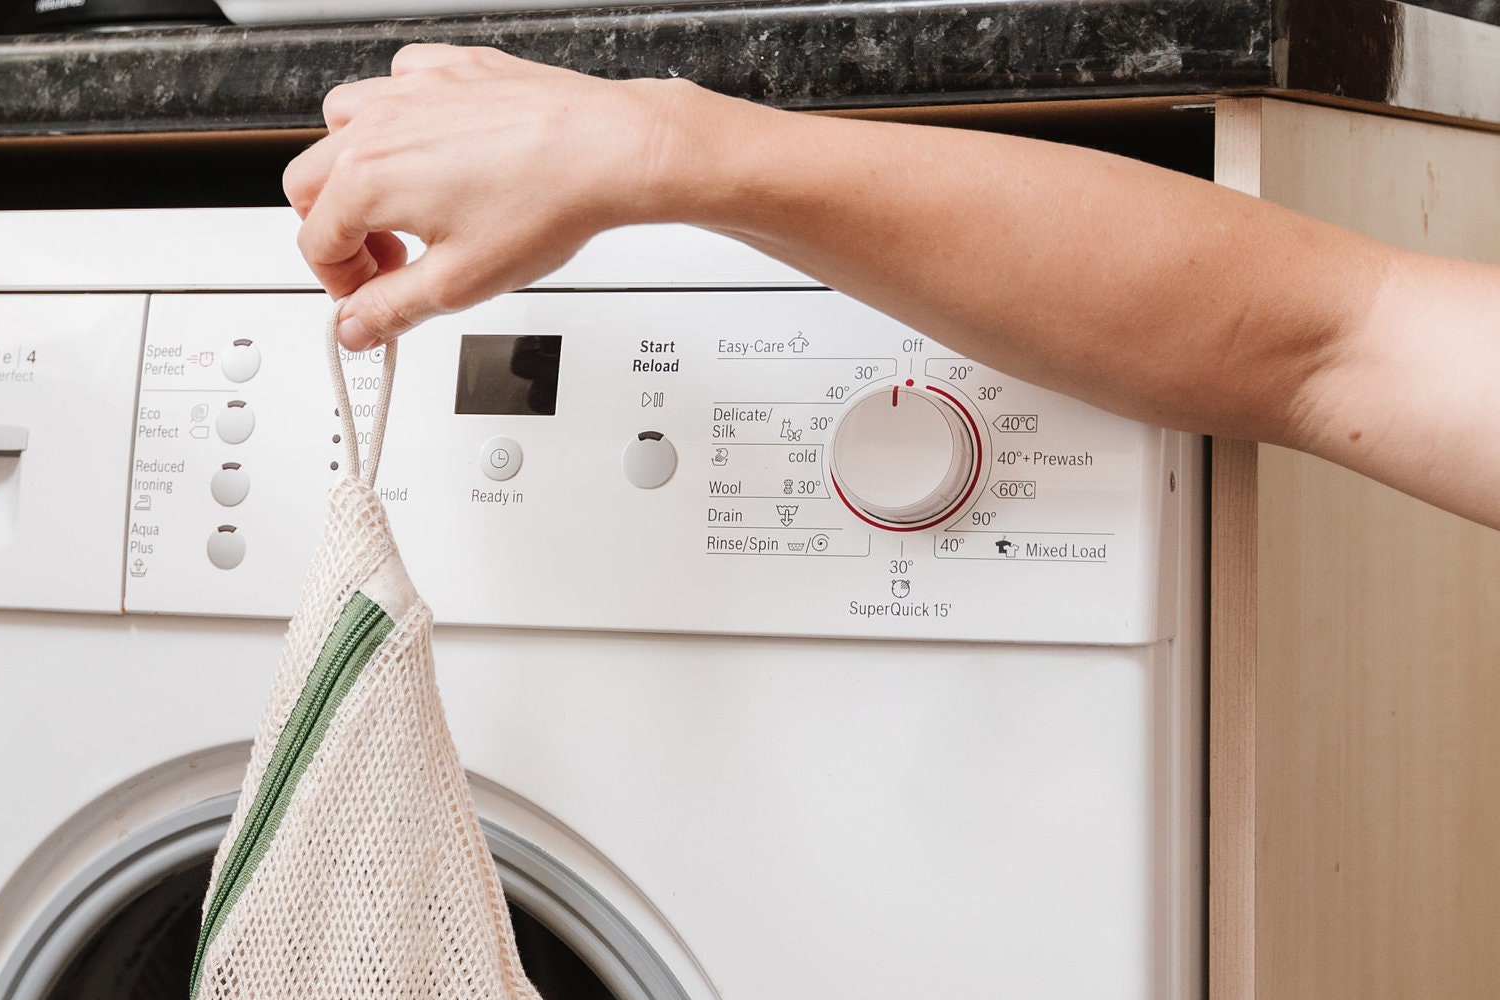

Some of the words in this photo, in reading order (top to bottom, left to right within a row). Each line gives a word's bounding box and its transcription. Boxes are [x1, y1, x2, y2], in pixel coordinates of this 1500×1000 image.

[145, 343, 183, 360] Speed
[639, 340, 676, 354] Start
[717, 340, 786, 355] Easy-Care
[901, 338, 925, 354] Off
[26, 348, 37, 364] 4
[144, 363, 186, 377] Perfect
[632, 358, 680, 374] Reload
[854, 366, 880, 381] 30°
[948, 366, 974, 381] 20°
[351, 376, 381, 391] 1200
[825, 386, 850, 401] 40°
[977, 386, 1003, 401] 30°
[139, 407, 162, 421] Eco
[713, 408, 774, 424] Delicate/
[810, 416, 834, 431] 30°
[1001, 416, 1036, 431] 40°C
[138, 425, 180, 439] Perfect
[712, 424, 737, 439] Silk
[787, 450, 817, 464] cold
[1033, 451, 1094, 467] Prewash
[135, 459, 186, 474] Reduced
[133, 477, 174, 494] Ironing
[708, 481, 743, 496] Wool
[796, 480, 822, 495] 30°
[999, 481, 1034, 498] 60°C
[379, 487, 409, 501] Hold
[471, 488, 511, 506] Ready
[511, 488, 524, 504] in
[706, 508, 744, 524] Drain
[972, 511, 997, 526] 90°
[130, 522, 160, 540] Aqua
[130, 540, 155, 555] Plus
[706, 536, 780, 554] Rinse/Spin
[939, 537, 965, 552] 40°
[1025, 543, 1067, 559] Mixed
[1070, 543, 1108, 560] Load
[889, 560, 915, 575] 30°
[848, 601, 930, 620] SuperQuick
